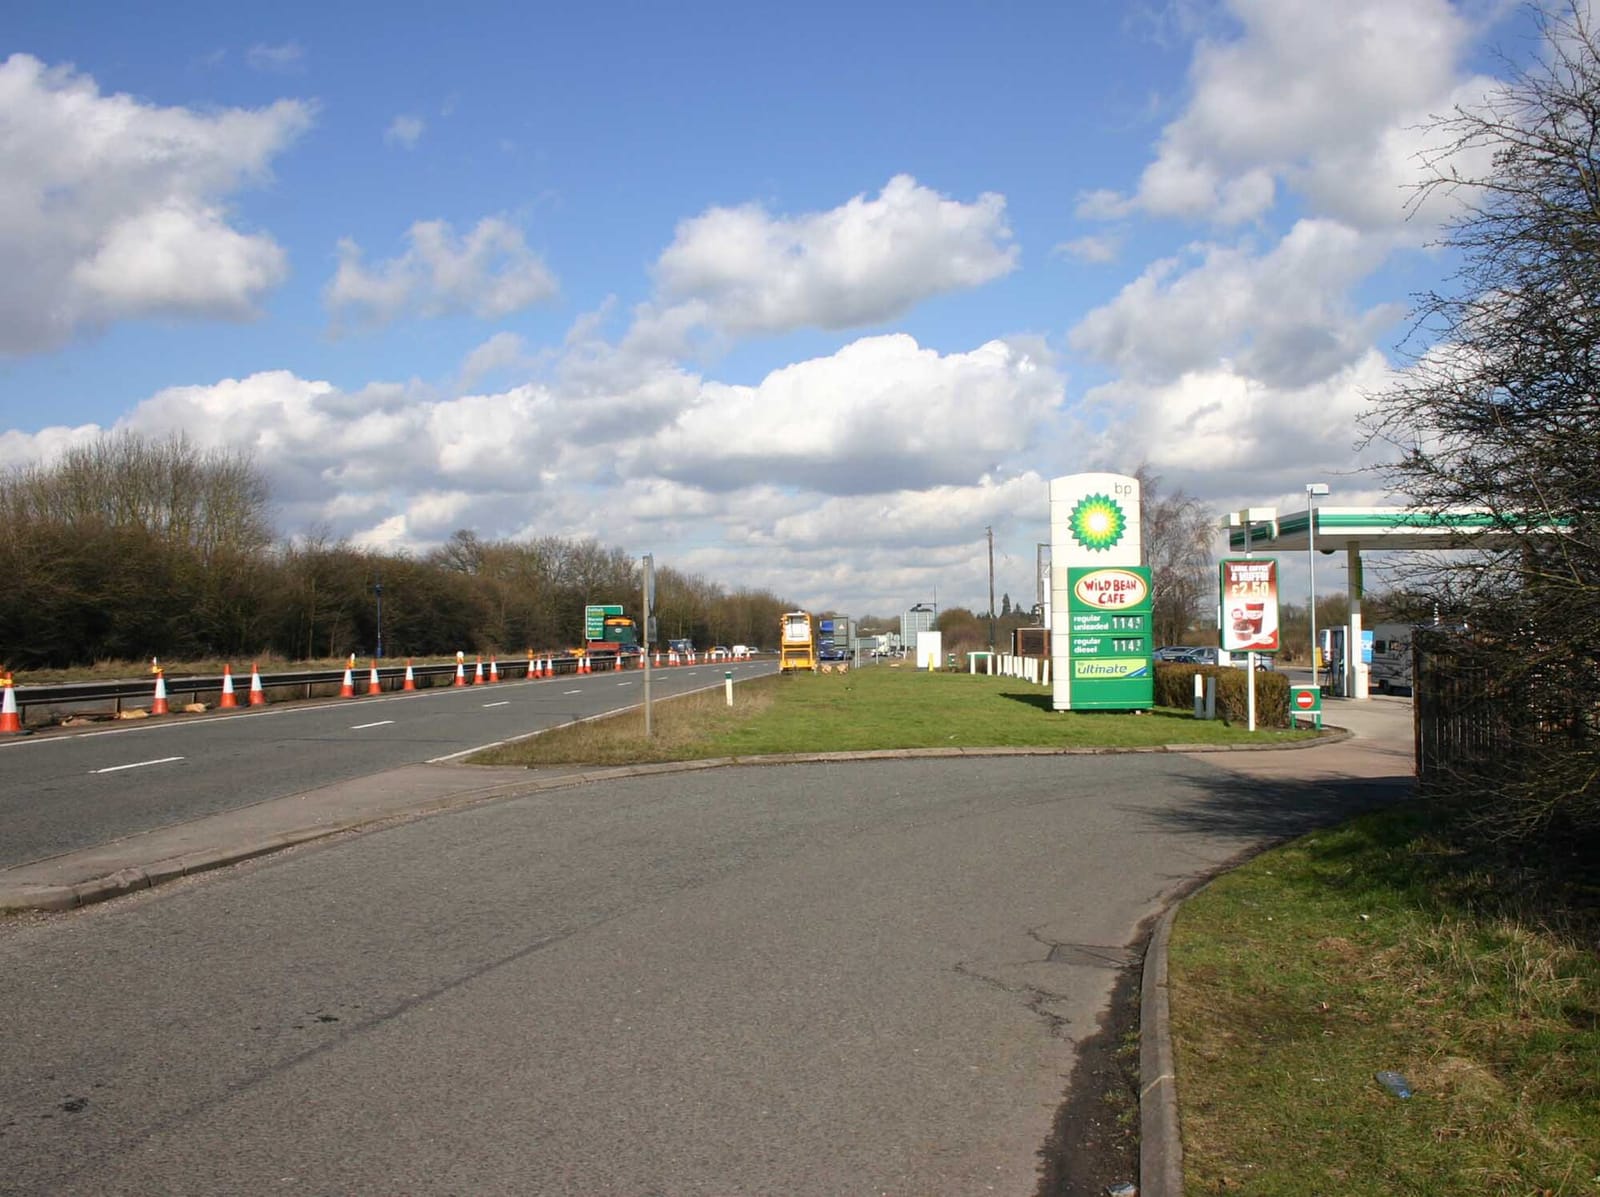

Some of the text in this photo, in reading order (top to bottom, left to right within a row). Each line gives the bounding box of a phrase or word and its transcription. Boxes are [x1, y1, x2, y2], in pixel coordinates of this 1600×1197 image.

[1115, 482, 1132, 497] bp
[1113, 579, 1136, 592] BEAN
[1098, 592, 1125, 604] CAFE
[1074, 615, 1101, 624] regular
[1074, 622, 1109, 630] unleaded
[1074, 637, 1101, 646] regular
[1074, 646, 1098, 654] diesel
[1078, 664, 1128, 674] ultimate
